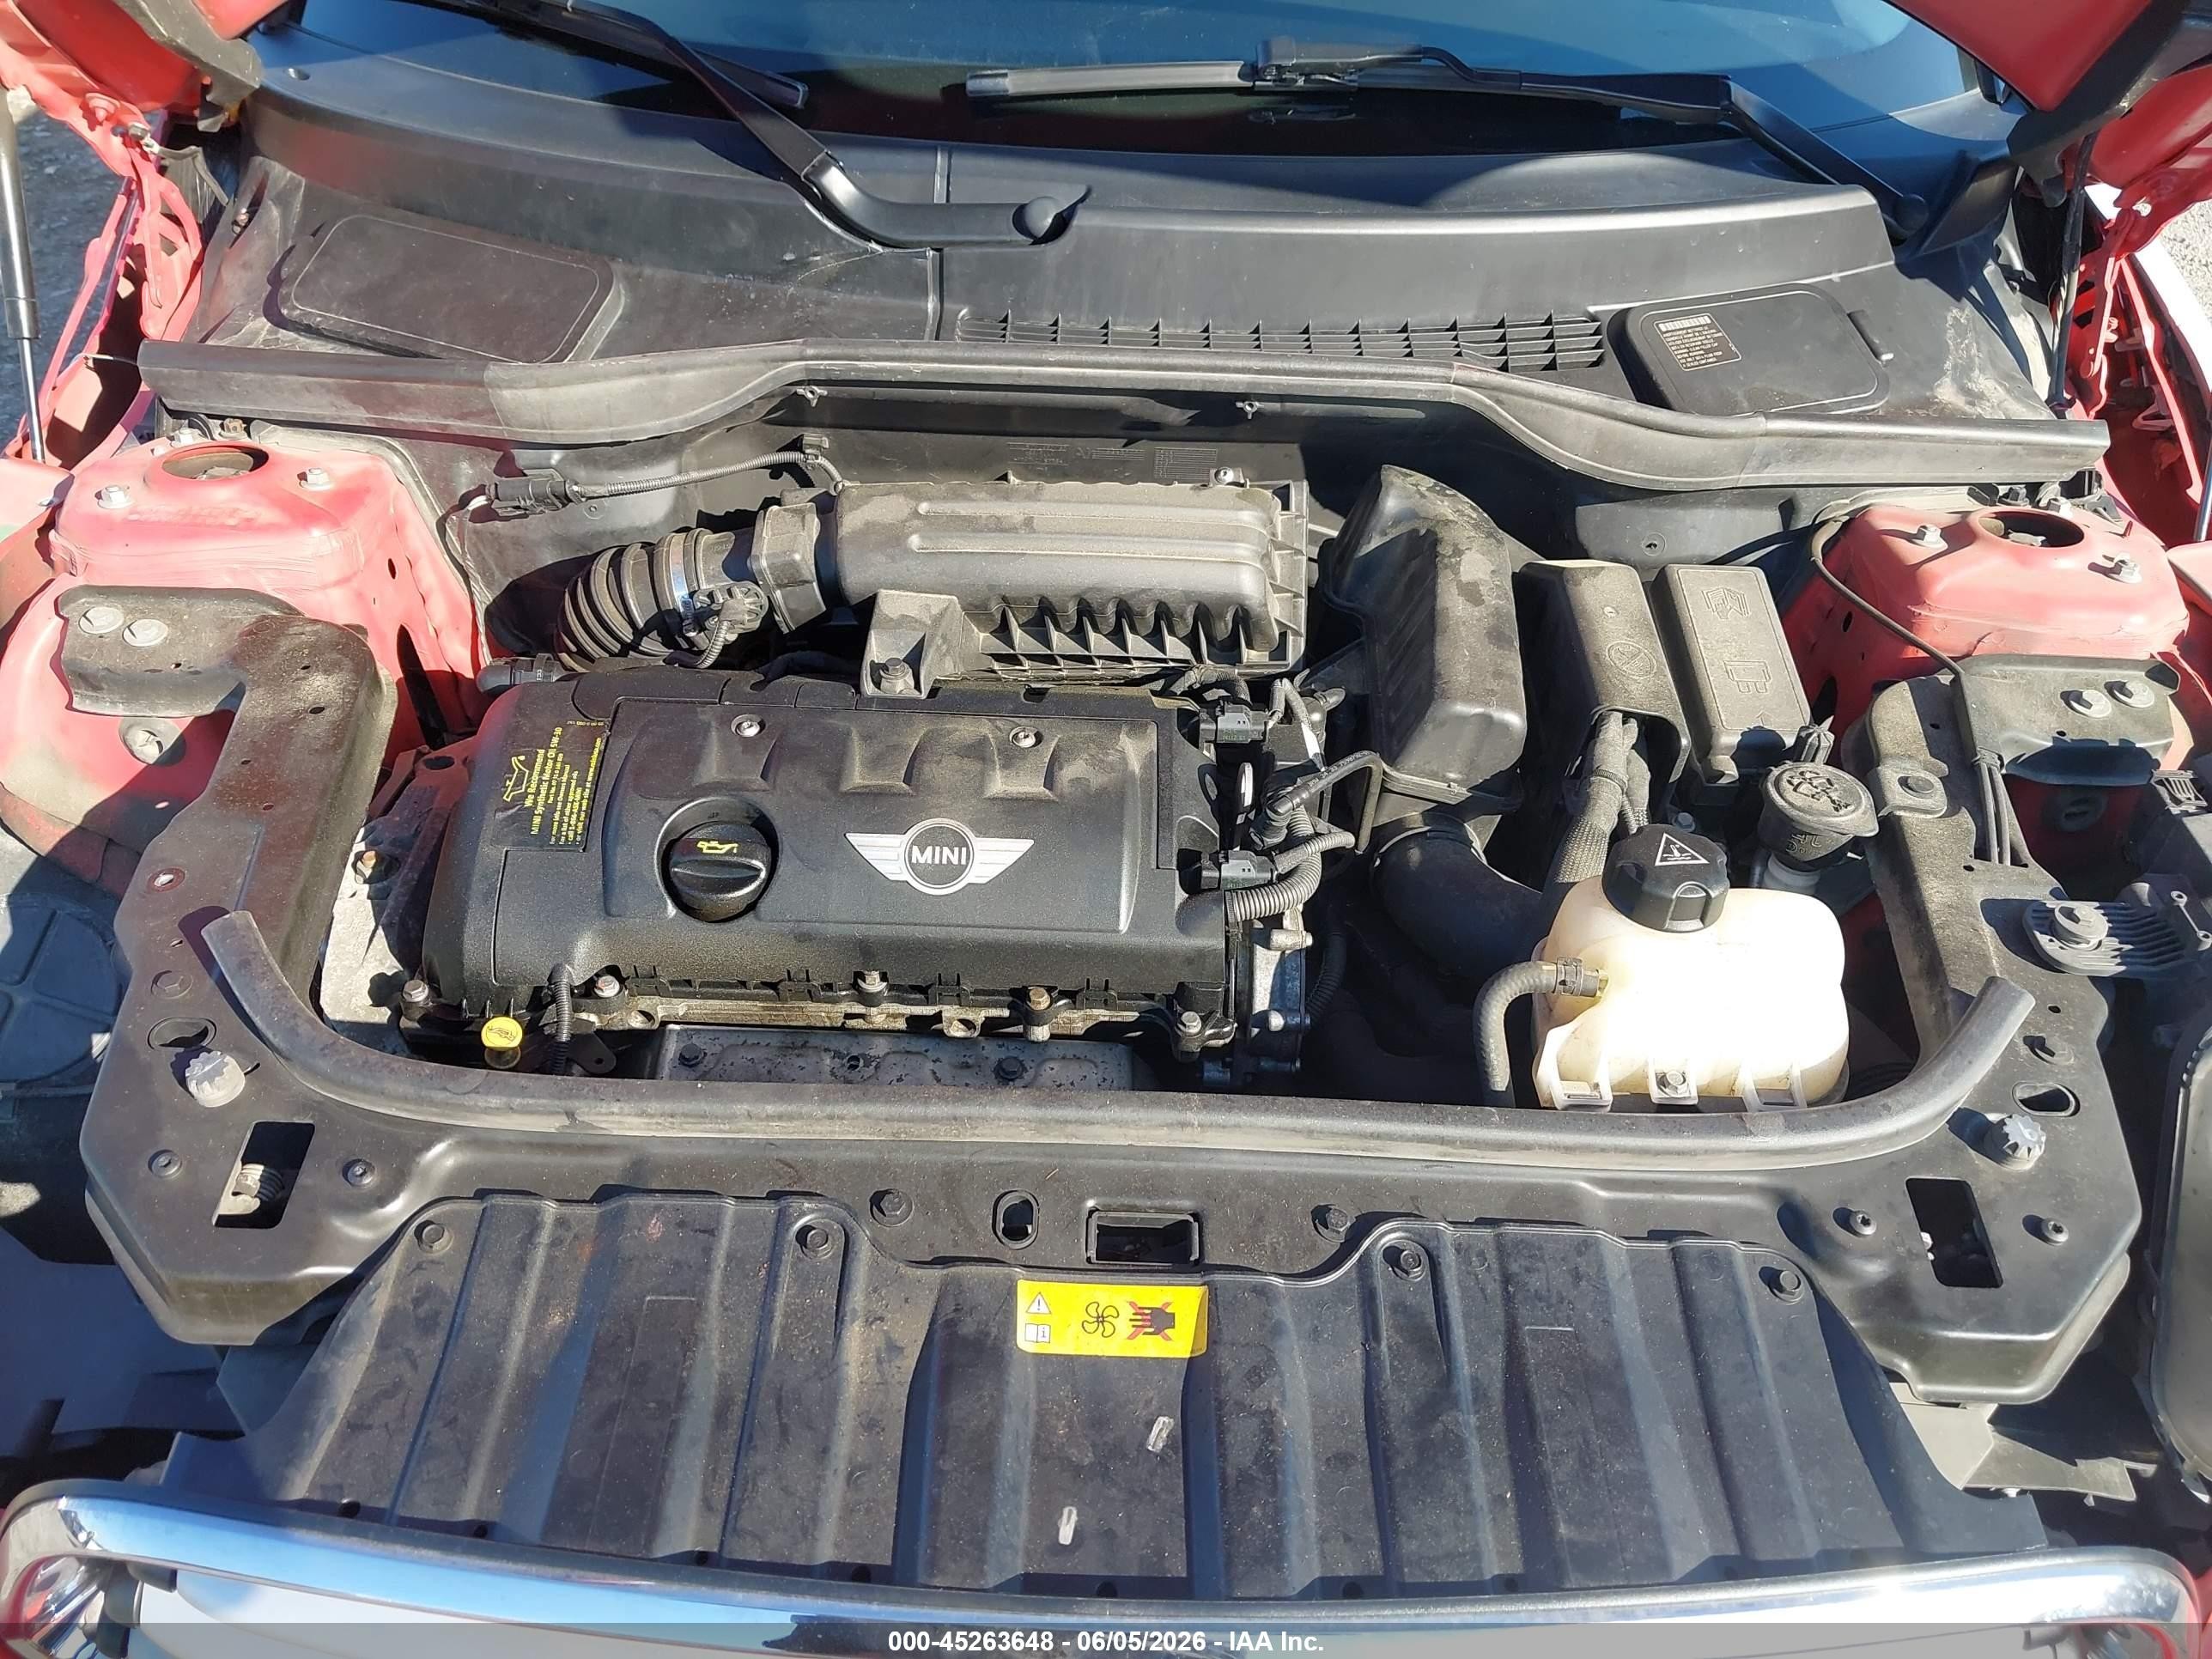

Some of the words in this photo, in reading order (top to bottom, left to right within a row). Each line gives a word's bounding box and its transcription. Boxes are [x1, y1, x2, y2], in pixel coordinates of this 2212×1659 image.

[550, 727, 562, 747] 5W-30
[547, 749, 556, 758] Oil
[527, 749, 545, 793] Recommend
[542, 759, 554, 780] Motor
[525, 794, 534, 807] We
[534, 781, 549, 814] Synthetic
[568, 779, 576, 802] approved
[531, 816, 542, 835] MINI
[911, 845, 967, 866] MINI
